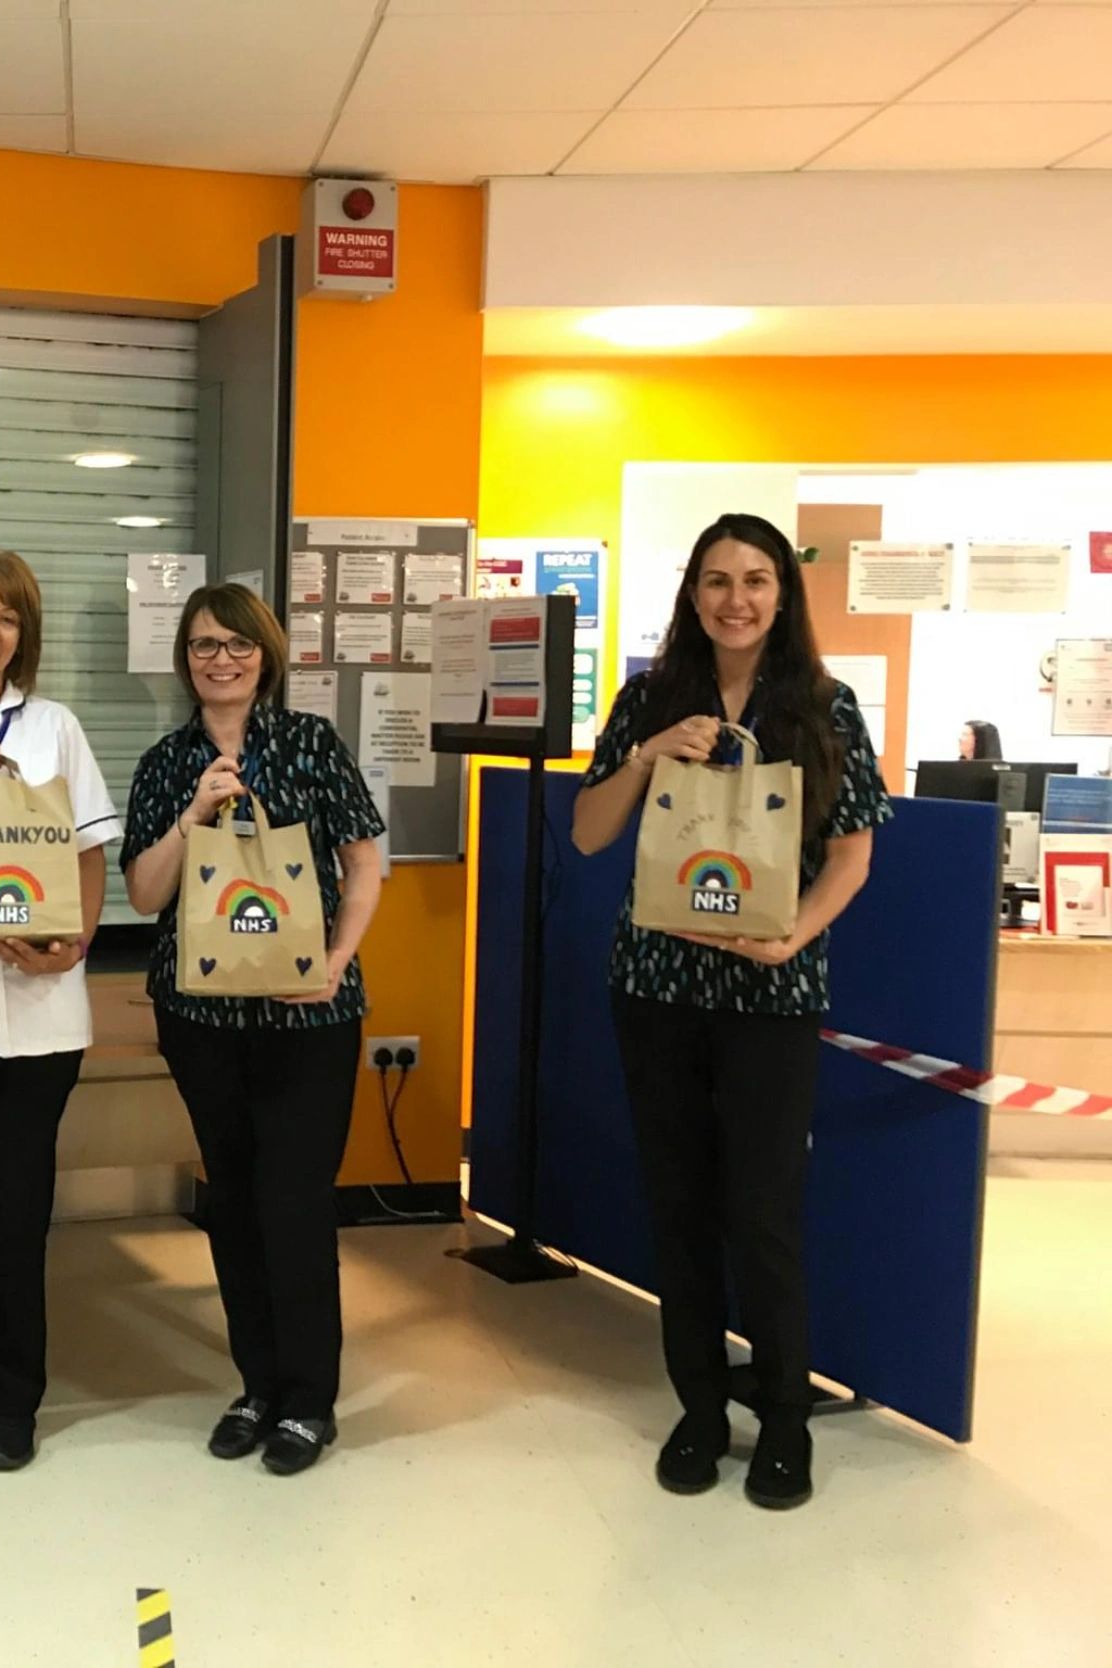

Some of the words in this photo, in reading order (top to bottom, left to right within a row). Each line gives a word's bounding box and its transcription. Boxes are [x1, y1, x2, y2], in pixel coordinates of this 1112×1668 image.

[326, 232, 387, 247] WARNING
[325, 247, 344, 257] FIRE
[348, 249, 387, 259] SHUTTER
[337, 260, 375, 270] CLOSING
[543, 554, 592, 567] REPEAT
[694, 891, 737, 912] NHS
[233, 918, 273, 932] NHS
